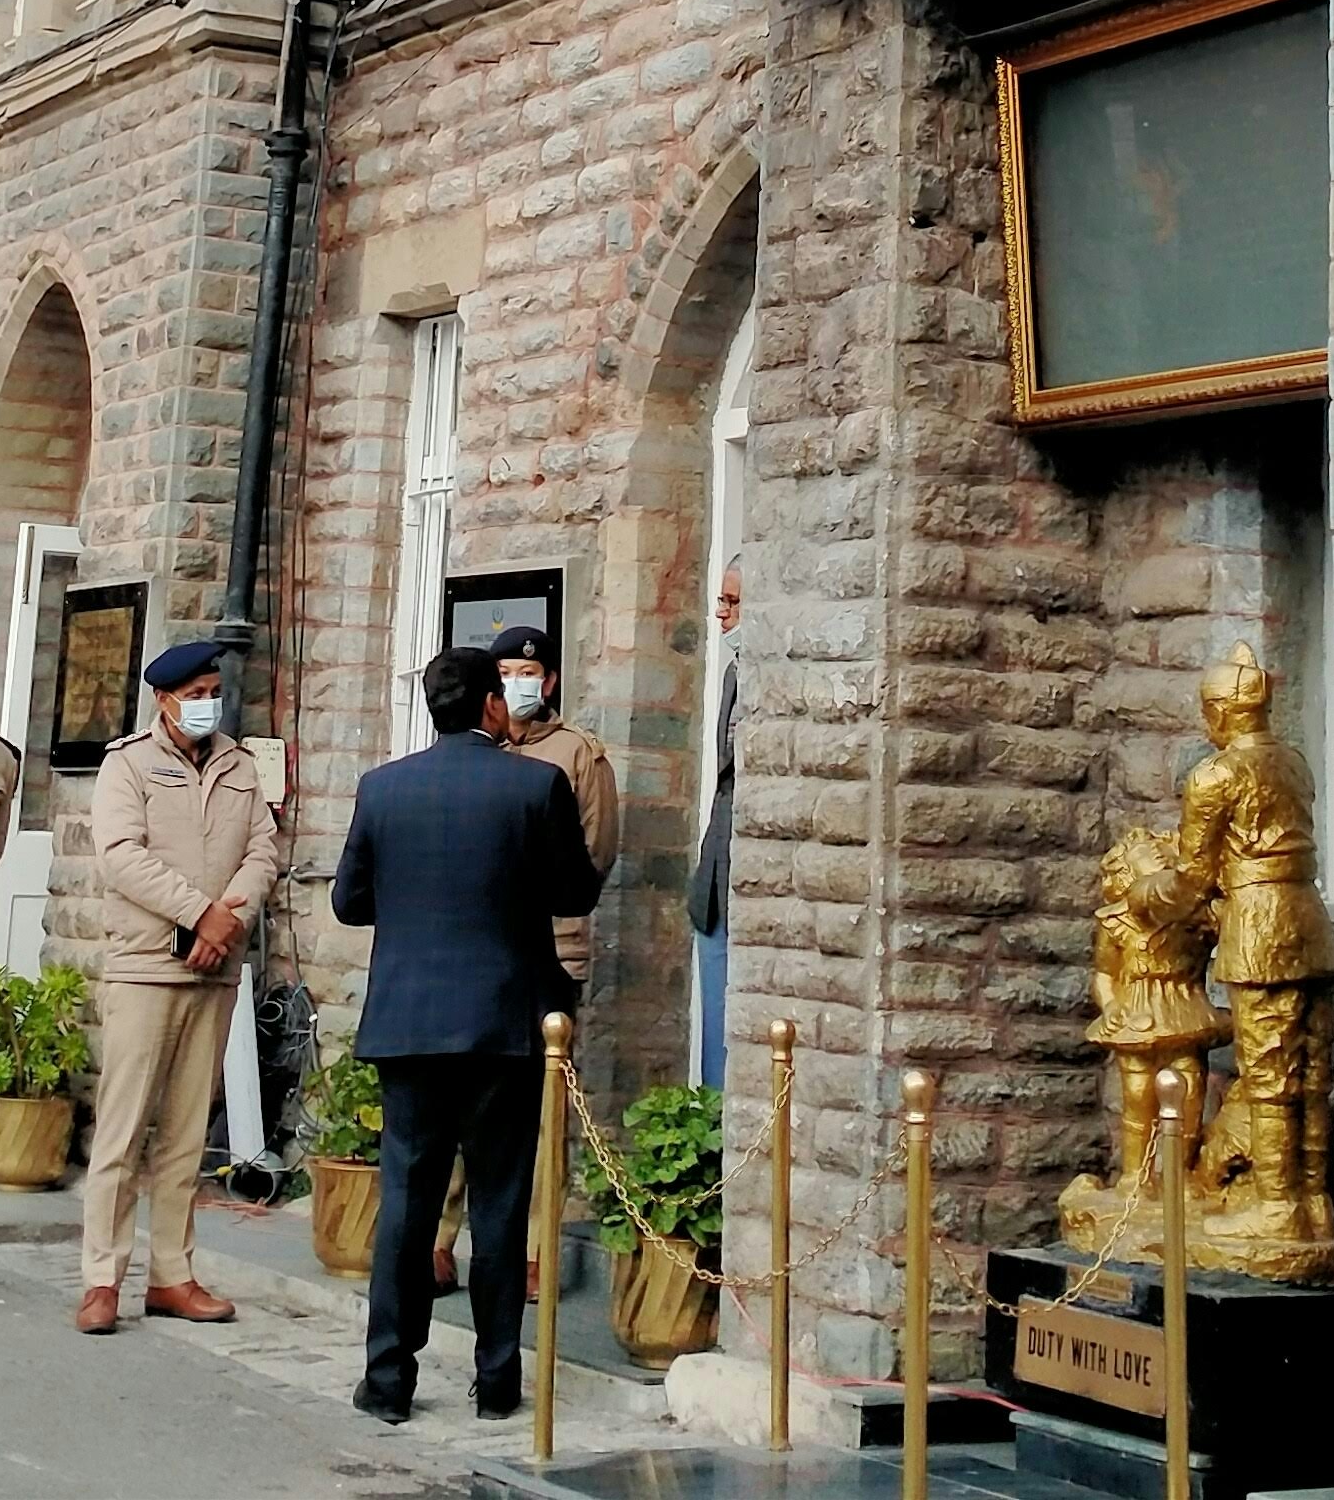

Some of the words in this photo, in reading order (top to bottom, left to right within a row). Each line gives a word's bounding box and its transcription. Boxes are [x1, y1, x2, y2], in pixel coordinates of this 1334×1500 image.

[1028, 1326, 1063, 1362] DUTY
[1071, 1336, 1107, 1374] WITH
[1114, 1348, 1151, 1387] LOVE
